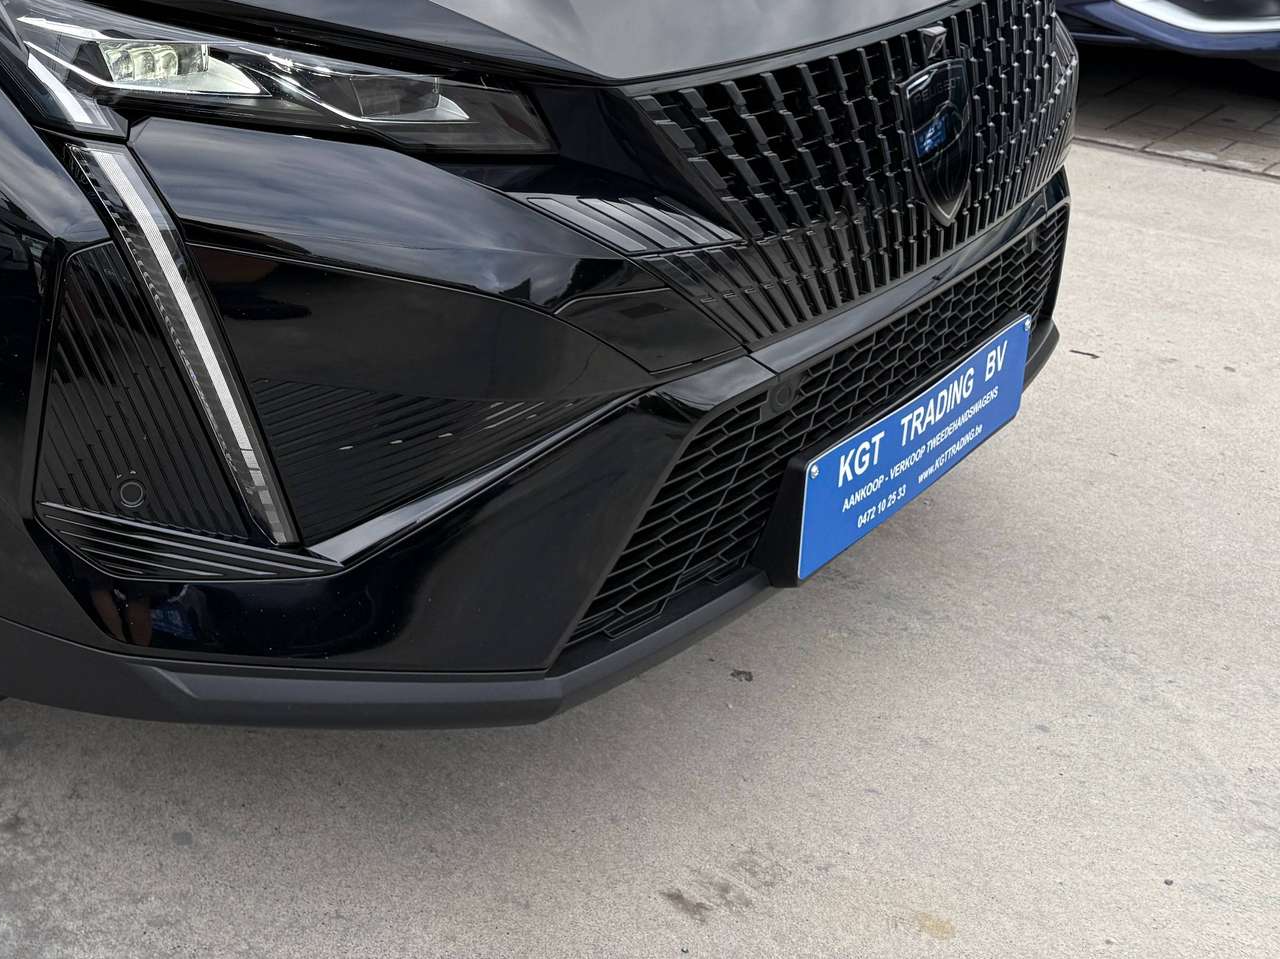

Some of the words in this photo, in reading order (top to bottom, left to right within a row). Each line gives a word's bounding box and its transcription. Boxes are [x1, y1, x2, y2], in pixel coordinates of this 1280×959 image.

[838, 431, 885, 488] KGT
[900, 367, 974, 447] TRADING
[985, 340, 1008, 382] BV
[842, 474, 885, 513] AANKOOP
[889, 445, 926, 480] VERKOOP
[926, 386, 999, 453] TWEEDEHANDSWAGENS
[857, 506, 876, 528] 0472
[877, 498, 887, 514] 10
[887, 491, 897, 508] 25
